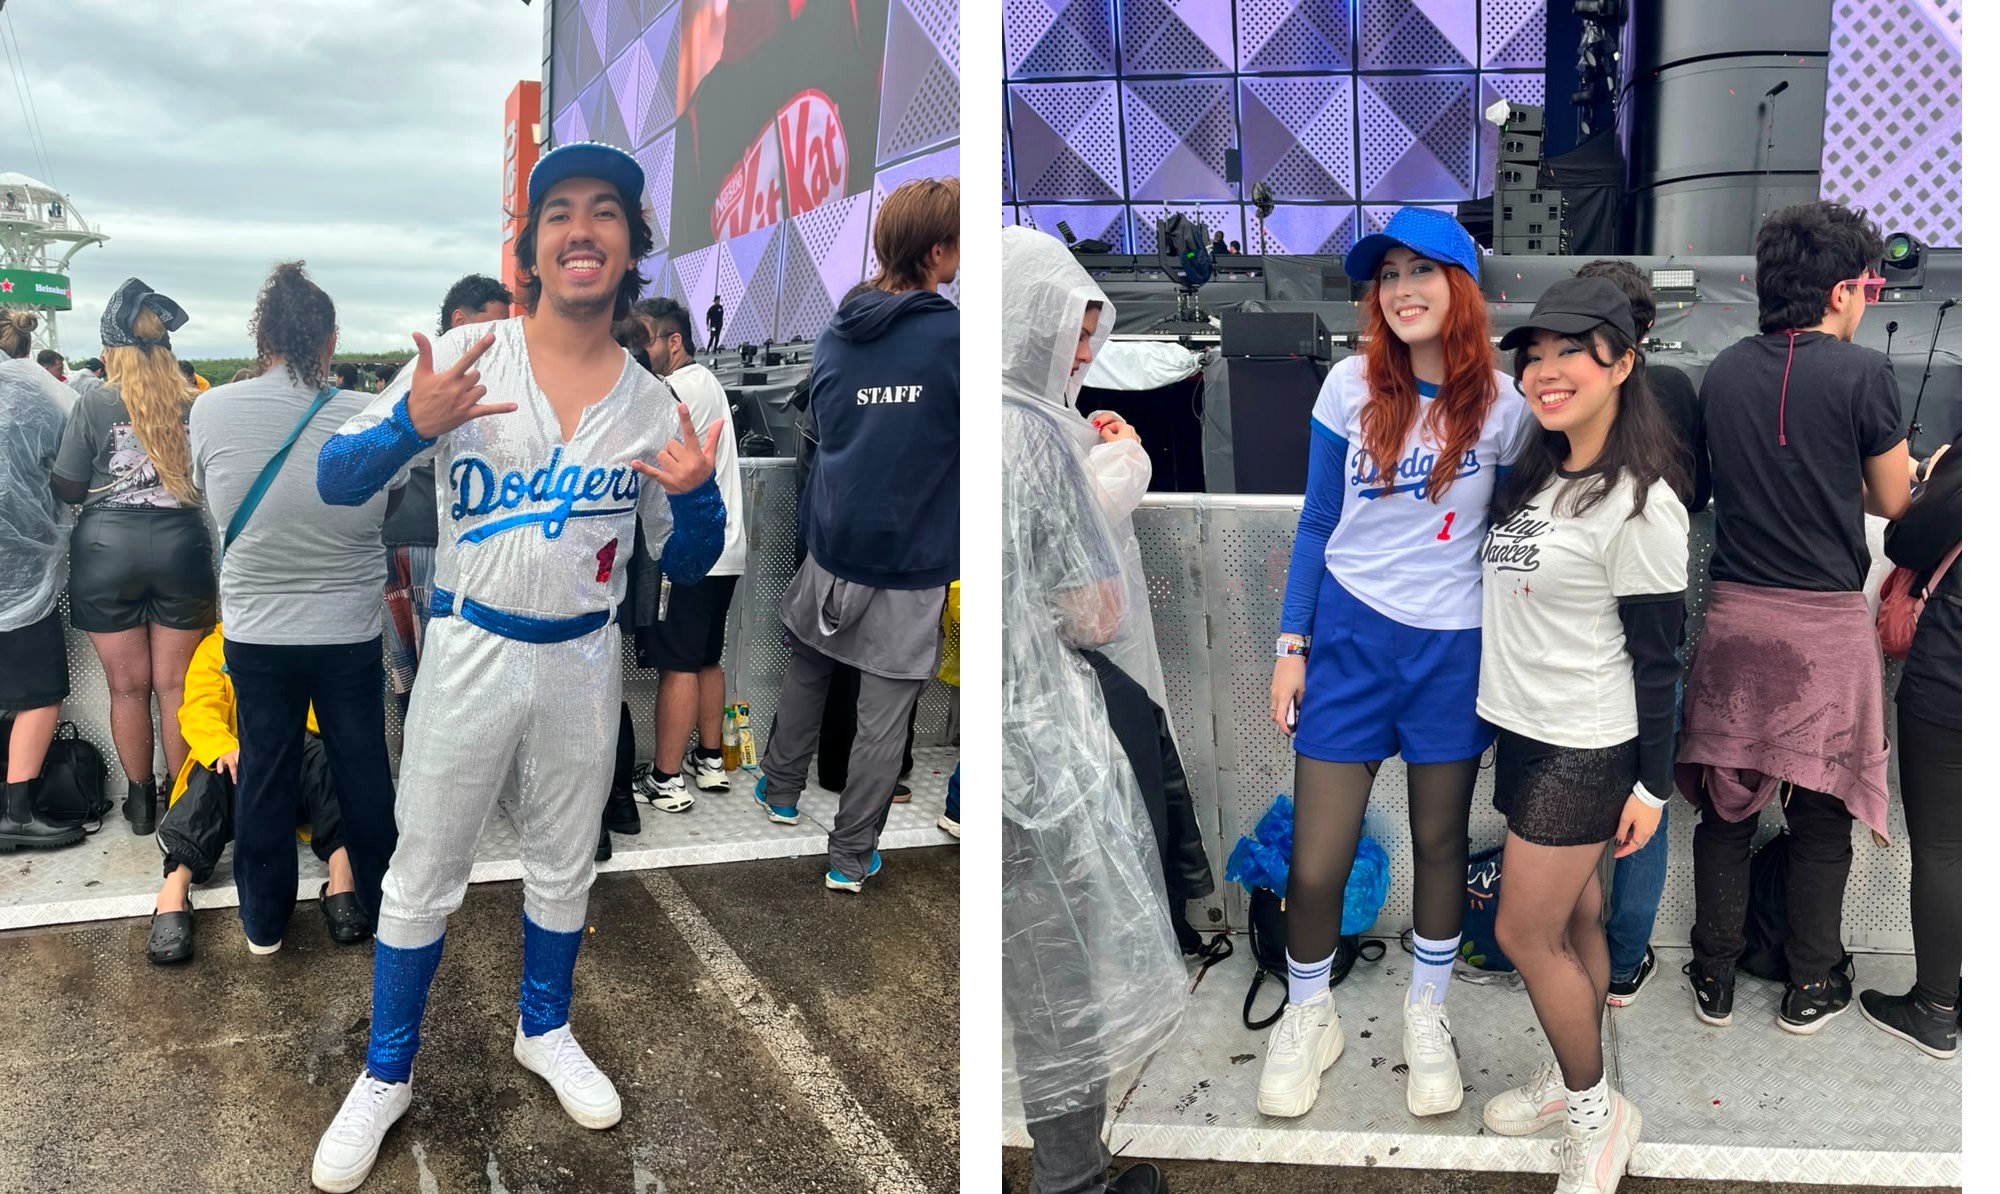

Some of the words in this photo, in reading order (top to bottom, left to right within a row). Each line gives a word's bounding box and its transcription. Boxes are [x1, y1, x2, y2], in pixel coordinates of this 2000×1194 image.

[857, 385, 923, 405] STAFF
[450, 446, 641, 541] Dodgers
[1351, 447, 1480, 500] Ddgs
[1437, 512, 1456, 540] 1
[596, 537, 618, 584] 1
